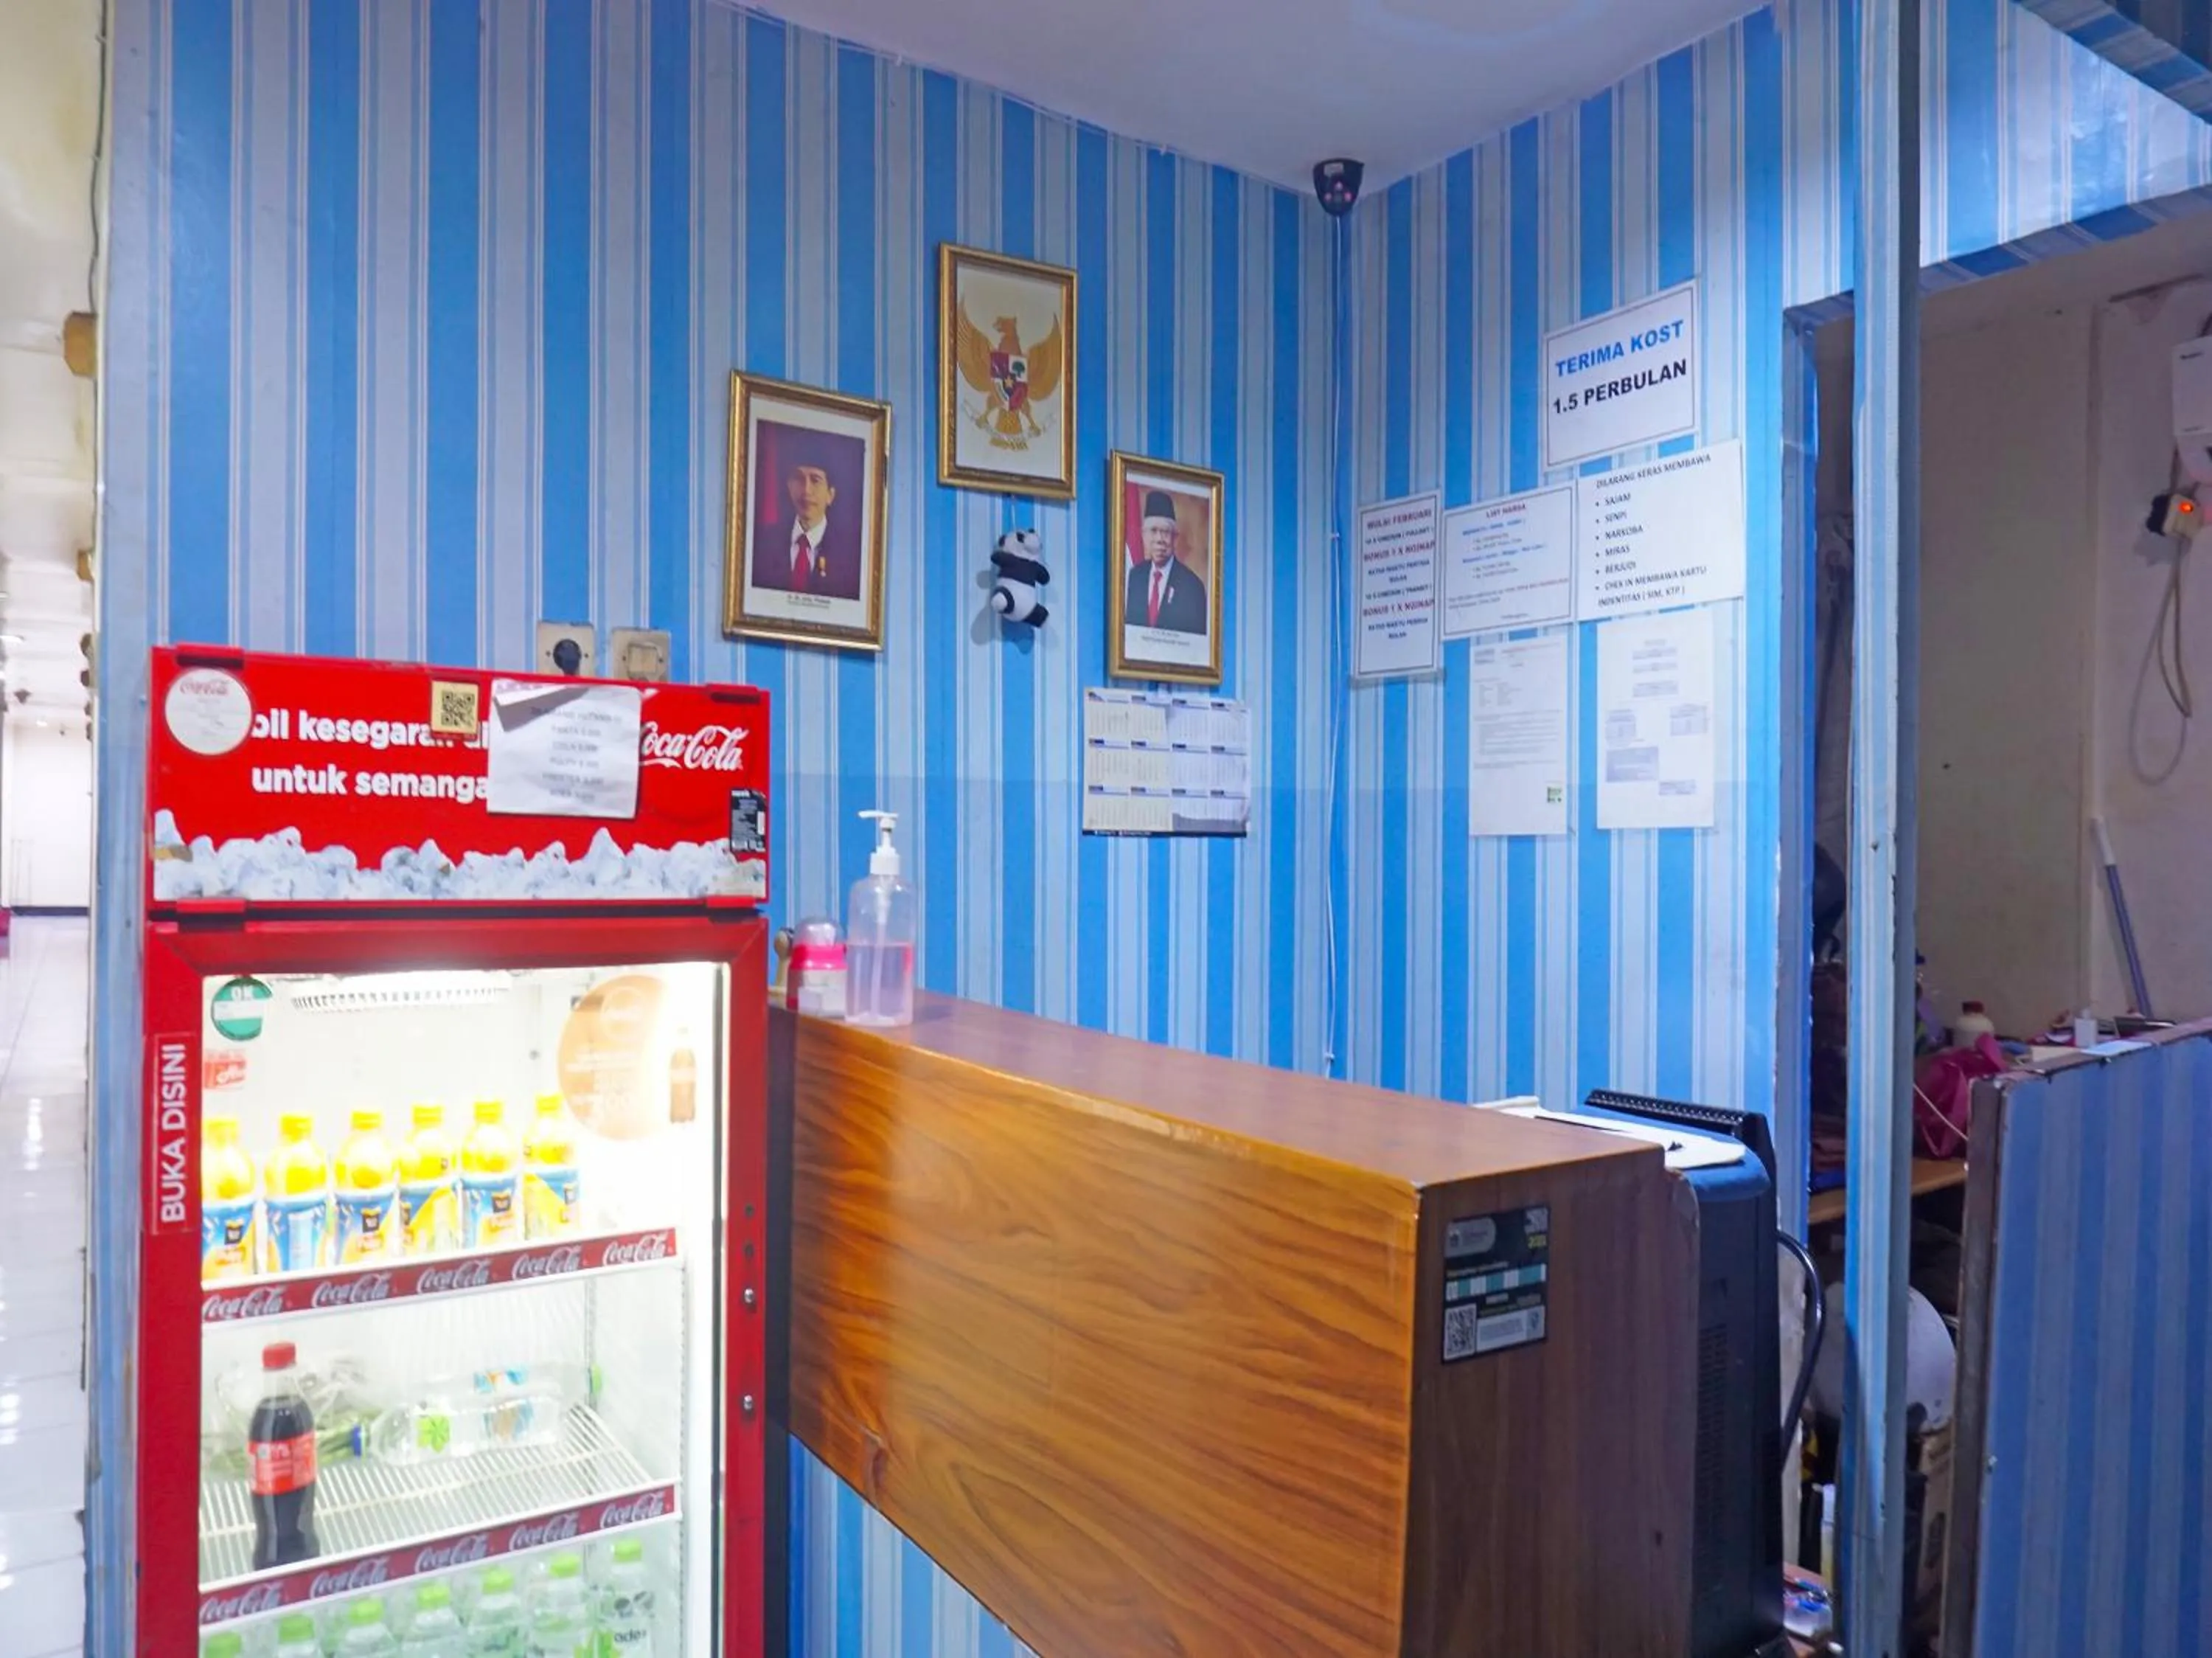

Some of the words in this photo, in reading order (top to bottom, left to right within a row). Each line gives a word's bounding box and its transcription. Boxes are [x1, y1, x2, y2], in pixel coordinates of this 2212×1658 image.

[1555, 341, 1624, 377] TERIMA
[1630, 319, 1683, 353] KOST
[1553, 392, 1578, 414] 1.5
[1584, 358, 1686, 406] PERBULAN
[1596, 473, 1635, 488] DILARANG
[1637, 464, 1662, 479] KERAS
[1663, 454, 1711, 474] MEMBAWA
[1605, 525, 1643, 539] NARKOBA
[299, 709, 453, 749] kesegara
[252, 764, 347, 794] untuk
[355, 771, 487, 804] semanga
[161, 1044, 186, 1131] DISINI
[161, 1136, 186, 1224] BUKA
